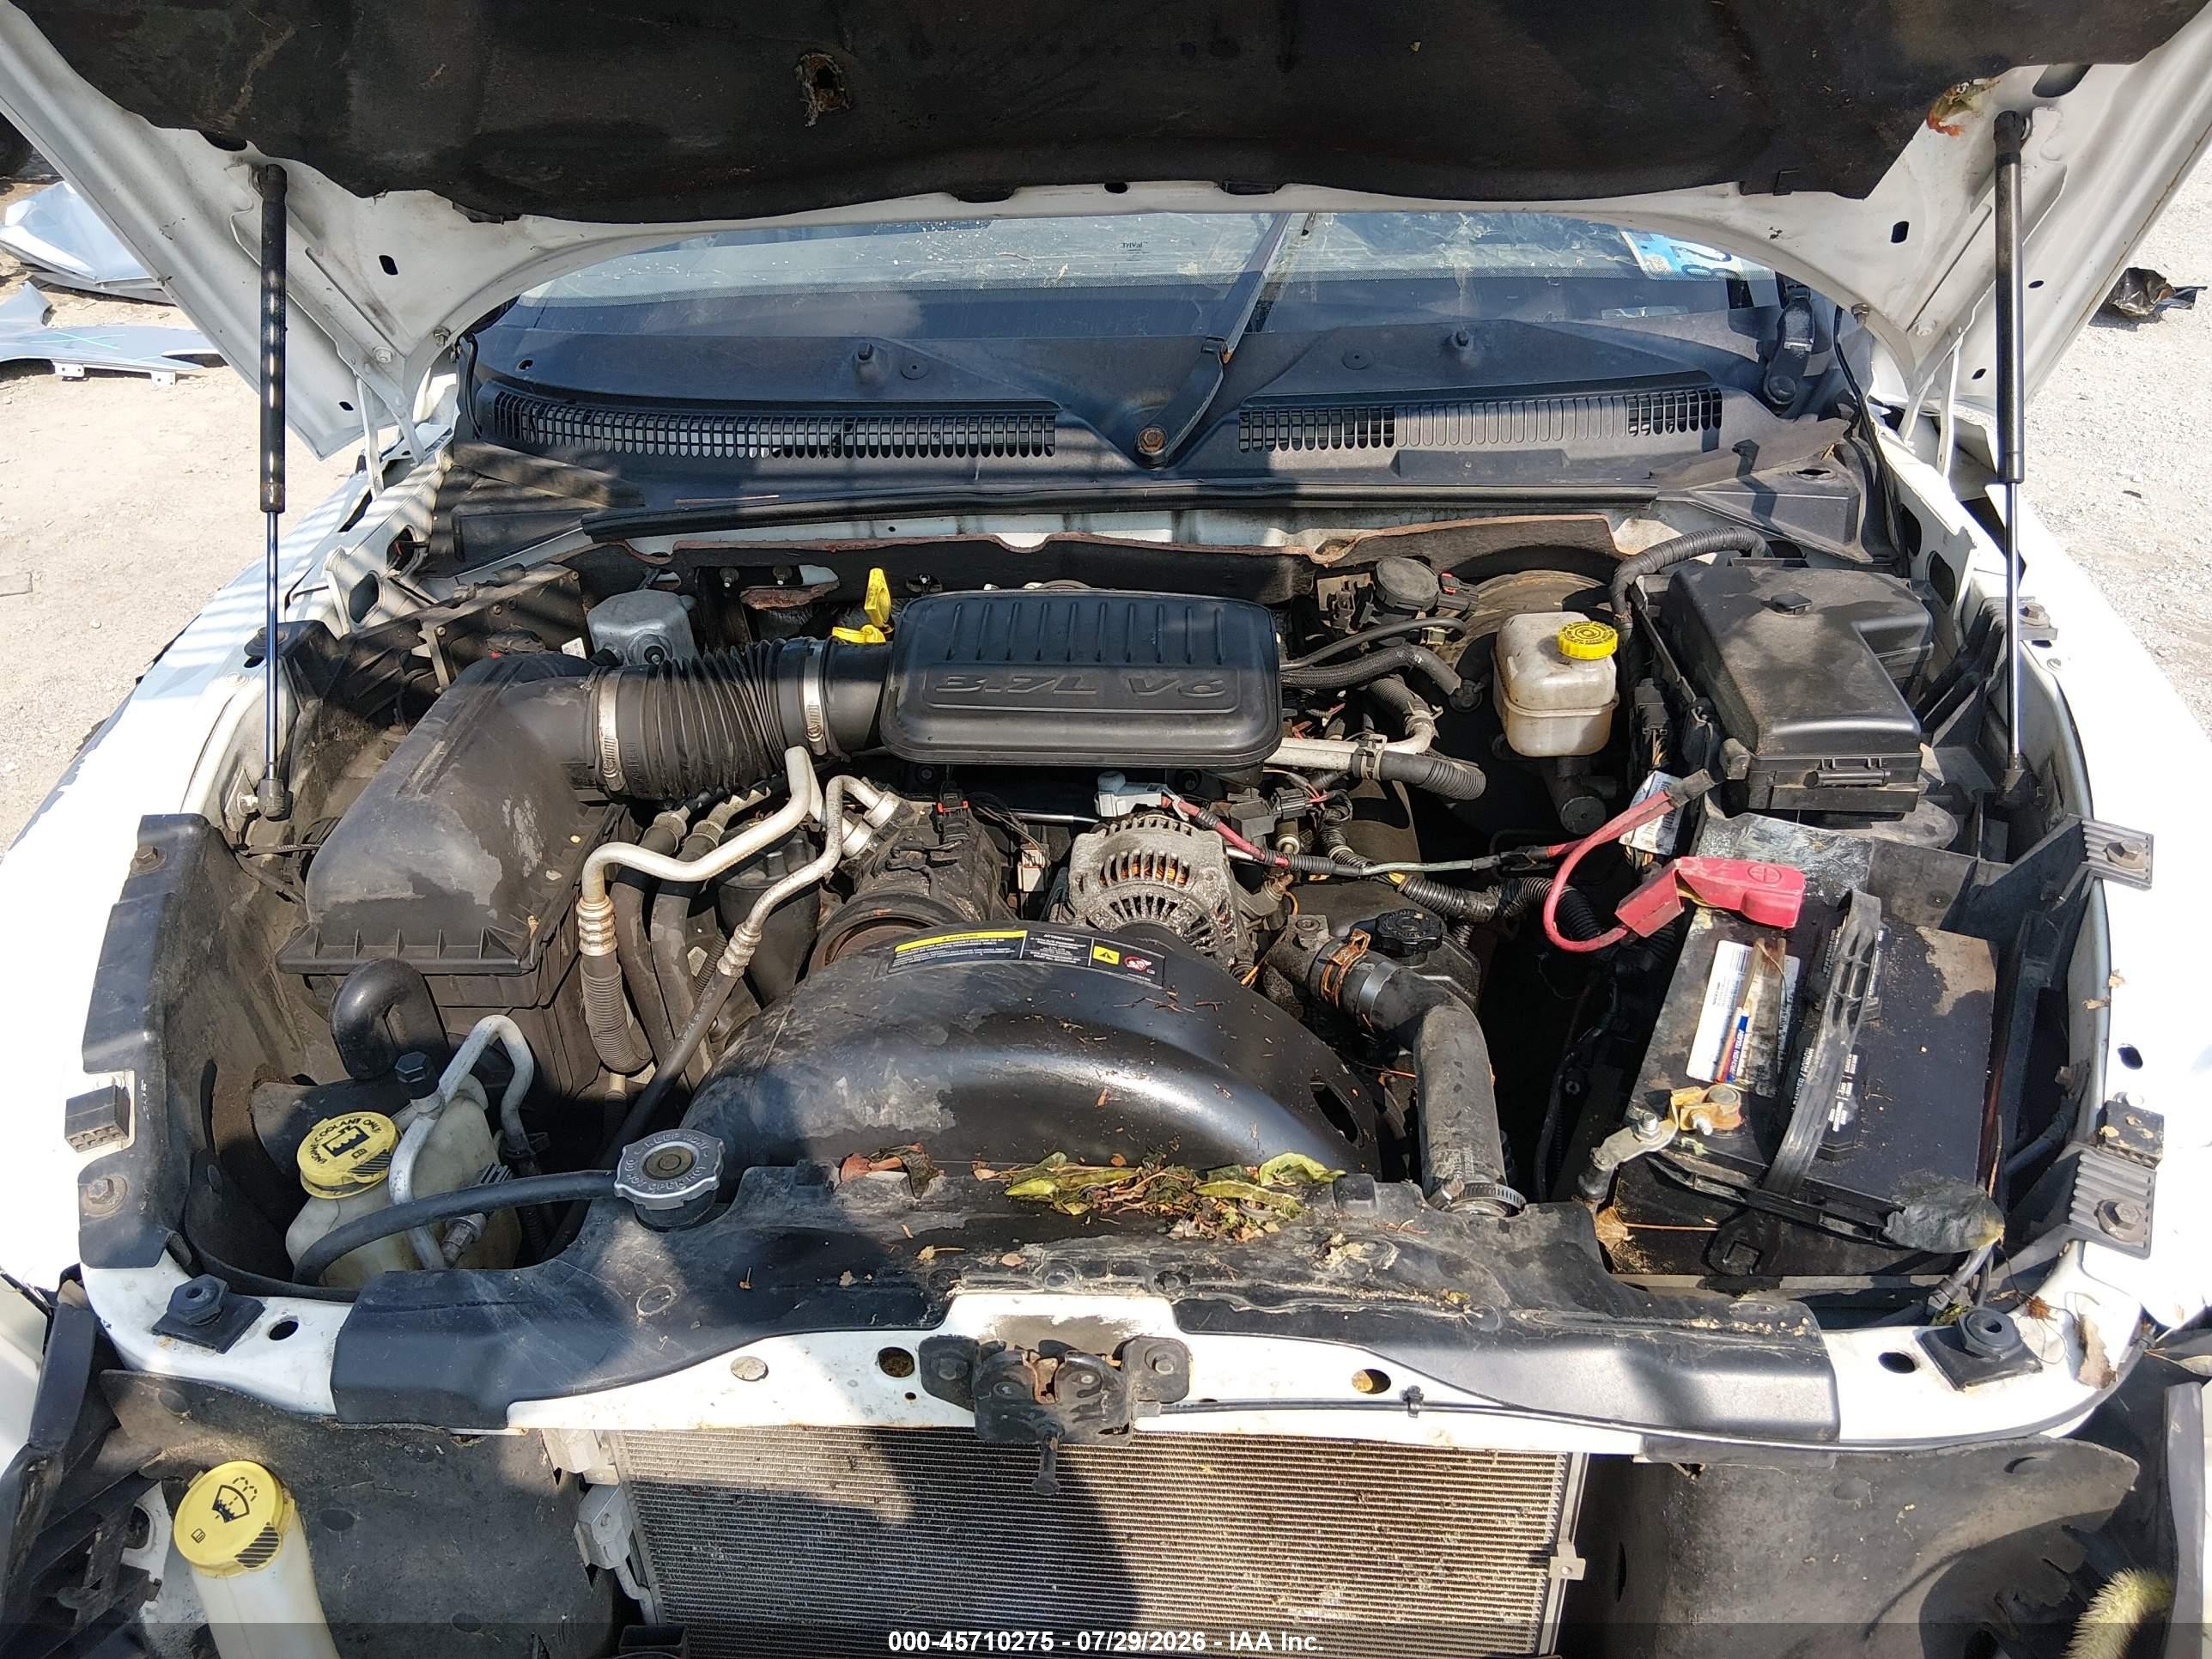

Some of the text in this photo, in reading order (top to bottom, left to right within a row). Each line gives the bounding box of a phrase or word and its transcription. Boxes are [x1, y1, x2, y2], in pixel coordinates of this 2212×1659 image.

[934, 674, 1226, 698] 3.7L V6
[309, 1118, 383, 1164] ENGINE COOLANT ONLY
[648, 1180, 685, 1192] OPEN
